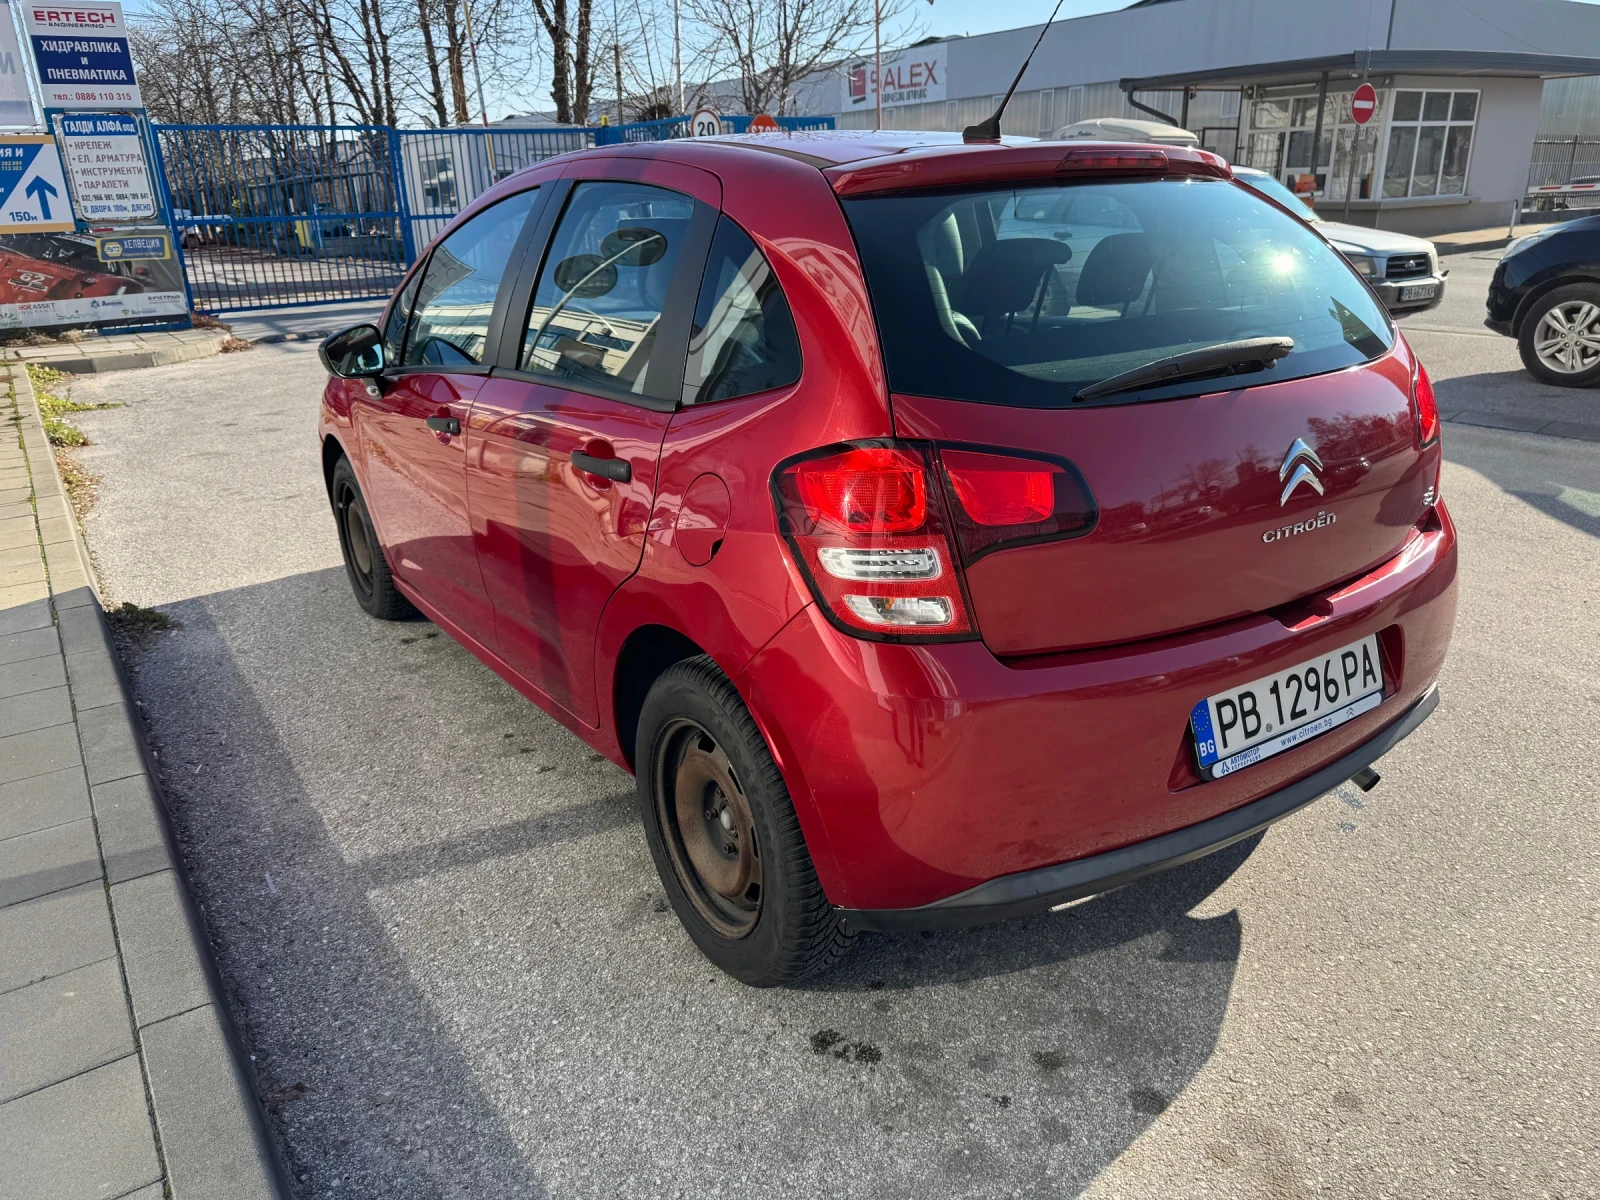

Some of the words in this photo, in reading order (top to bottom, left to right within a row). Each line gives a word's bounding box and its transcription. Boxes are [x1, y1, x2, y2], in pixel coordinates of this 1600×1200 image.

[33, 11, 115, 23] ERTECH
[40, 40, 121, 53] ХИДРАВЛИКА
[47, 69, 127, 80] ПНЕВМАТИКА
[871, 60, 938, 92] SALEX
[64, 121, 94, 133] ГАЛДИ
[97, 121, 122, 132] АЛФА
[698, 121, 715, 136] 20
[74, 141, 112, 150] КРЕПЕЖ
[78, 154, 92, 163] ЕЛ.
[96, 153, 142, 163] АРМАТУРА
[80, 167, 143, 176] ИНСТРУМЕНТИ
[84, 180, 129, 189] ПАРАПЕТИ
[91, 205, 112, 214] ДВОРА
[131, 203, 151, 213] ДЯСНО
[123, 239, 160, 249] ХЕЛВЕЦИЯ
[1215, 691, 1262, 749] PB
[1270, 659, 1340, 726] 1296
[1341, 643, 1377, 697] PA
[1281, 717, 1333, 746] www.citroen.bg
[1200, 740, 1215, 757] BG
